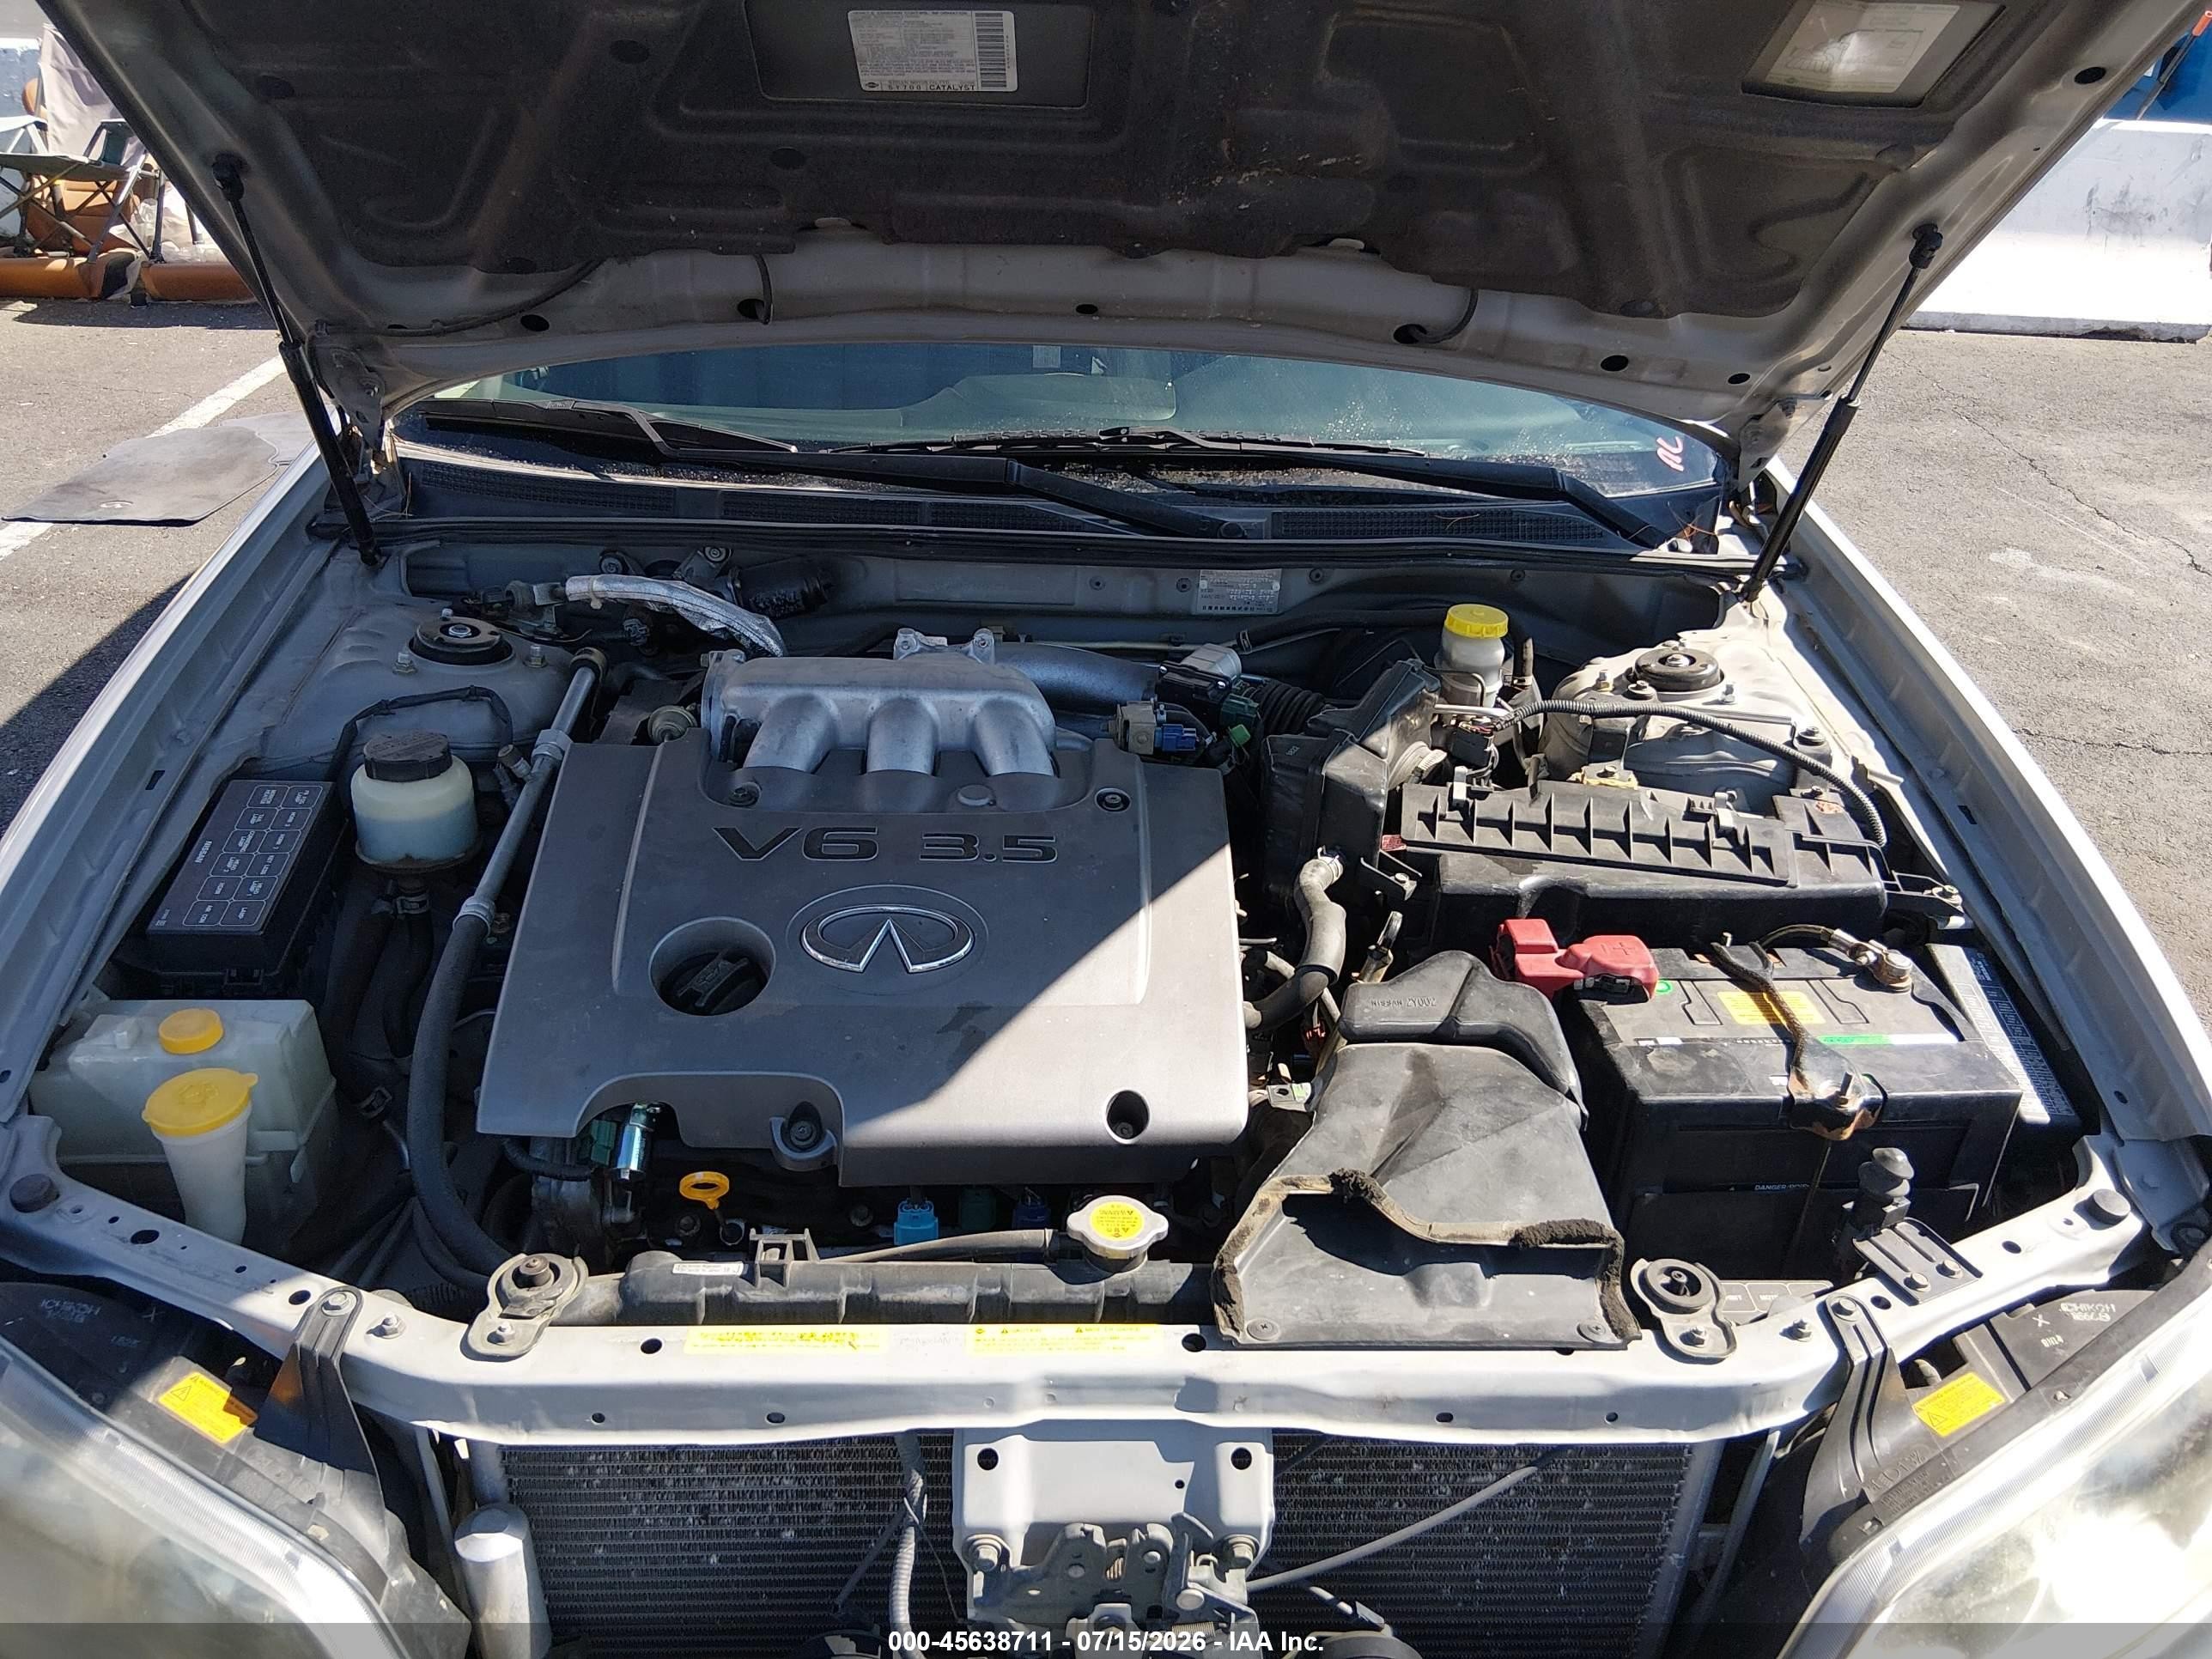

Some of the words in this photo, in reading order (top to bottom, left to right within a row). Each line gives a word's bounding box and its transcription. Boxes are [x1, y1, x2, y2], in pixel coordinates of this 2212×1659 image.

[195, 841, 212, 863] NISSAN
[712, 826, 879, 861] V6
[919, 833, 1059, 863] 3.5
[1370, 999, 1403, 1008] NISSAN
